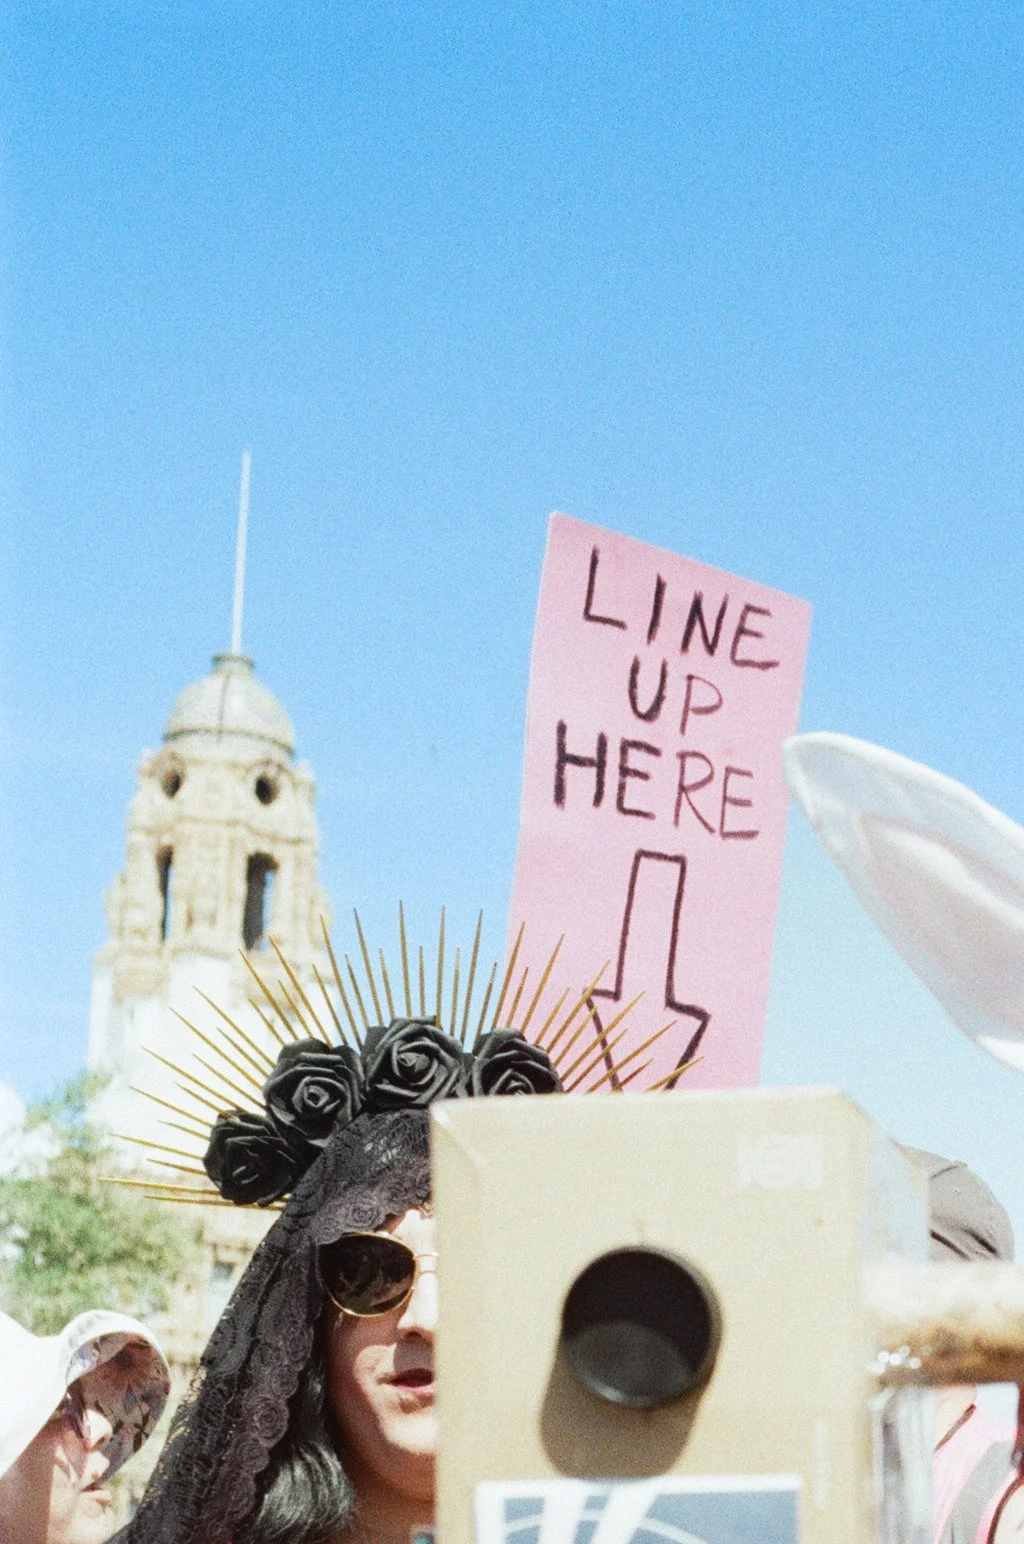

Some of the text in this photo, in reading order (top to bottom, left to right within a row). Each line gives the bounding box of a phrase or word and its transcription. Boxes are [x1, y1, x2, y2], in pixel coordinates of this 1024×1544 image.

[583, 545, 780, 670] LINE
[627, 654, 724, 736] UP
[552, 719, 760, 840] HERE
